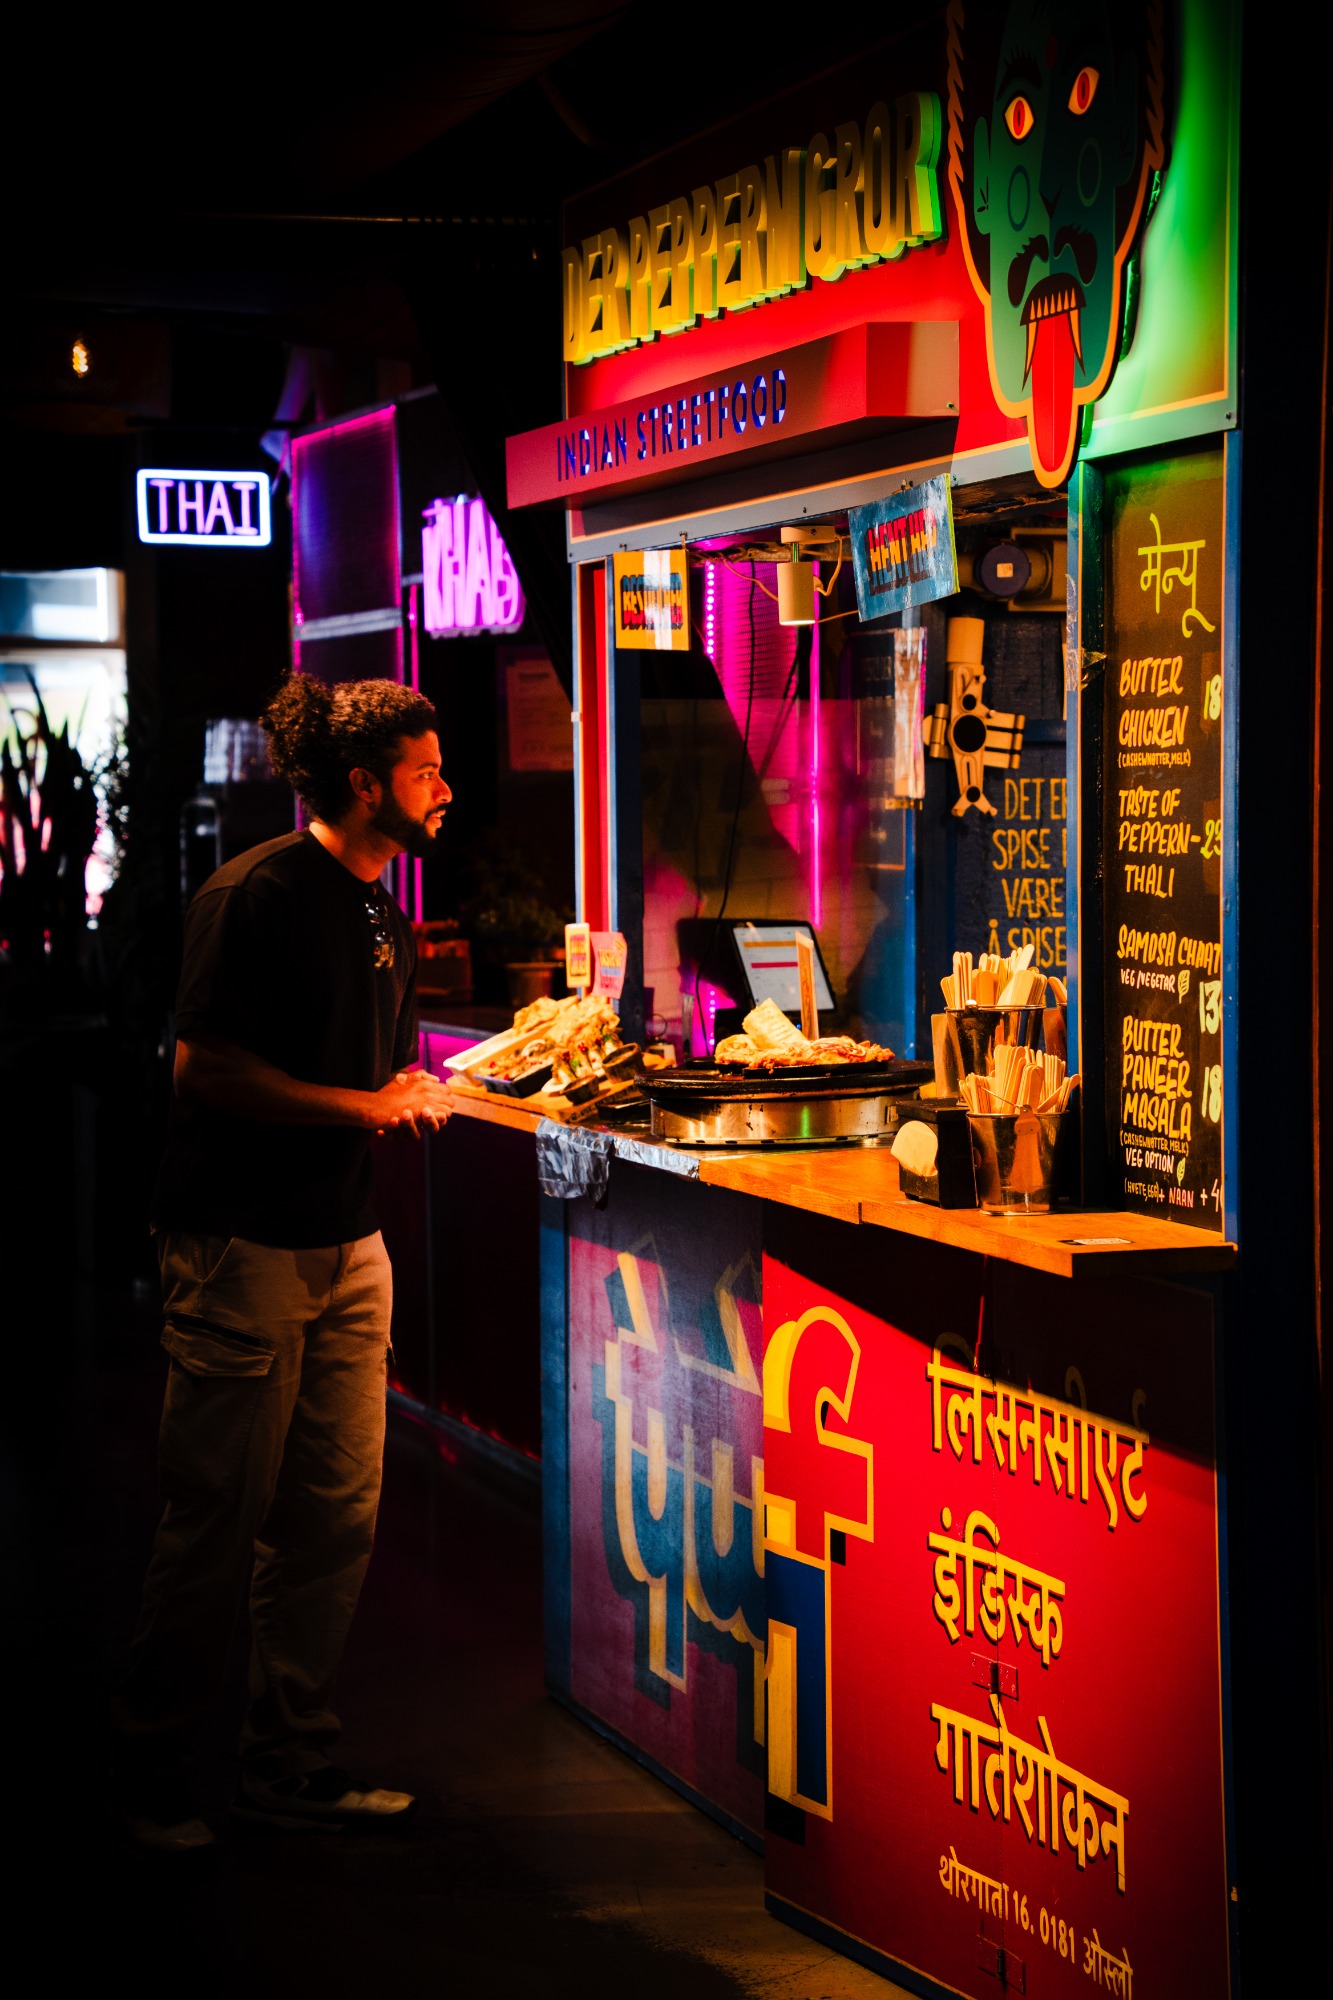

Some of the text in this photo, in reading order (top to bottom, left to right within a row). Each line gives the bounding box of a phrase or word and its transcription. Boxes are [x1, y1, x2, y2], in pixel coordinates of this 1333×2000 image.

[560, 91, 943, 366] DER PEPPERN GROR
[556, 368, 787, 482] INDIAN STREETFOOD
[149, 478, 259, 536] THAI
[865, 515, 911, 595] HENT
[1137, 512, 1216, 639] मेन्यू
[1119, 655, 1184, 698] BUTTER
[1118, 705, 1189, 748] CHICKEN
[1004, 777, 1046, 821] DET
[1118, 785, 1182, 818] TASTE OF
[991, 828, 1051, 870] SPISE
[1001, 877, 1064, 918] VÆRE
[1124, 863, 1175, 899] THALI
[1117, 923, 1222, 976] SAMOSA CHAAT
[1120, 968, 1136, 987] VEG
[1199, 979, 1223, 1035] 13
[1122, 1015, 1184, 1059] BUTTER
[1122, 1054, 1193, 1100] PANEER
[1123, 1092, 1192, 1142] MASALA
[1125, 1147, 1175, 1174] VEG OPTION
[1168, 1187, 1194, 1209] NAAN
[1211, 1178, 1223, 1213] 4
[927, 1507, 1066, 1667] इंडिस्क
[930, 1693, 1130, 1894] गातेशोकन
[1039, 1906, 1076, 1965] 0181
